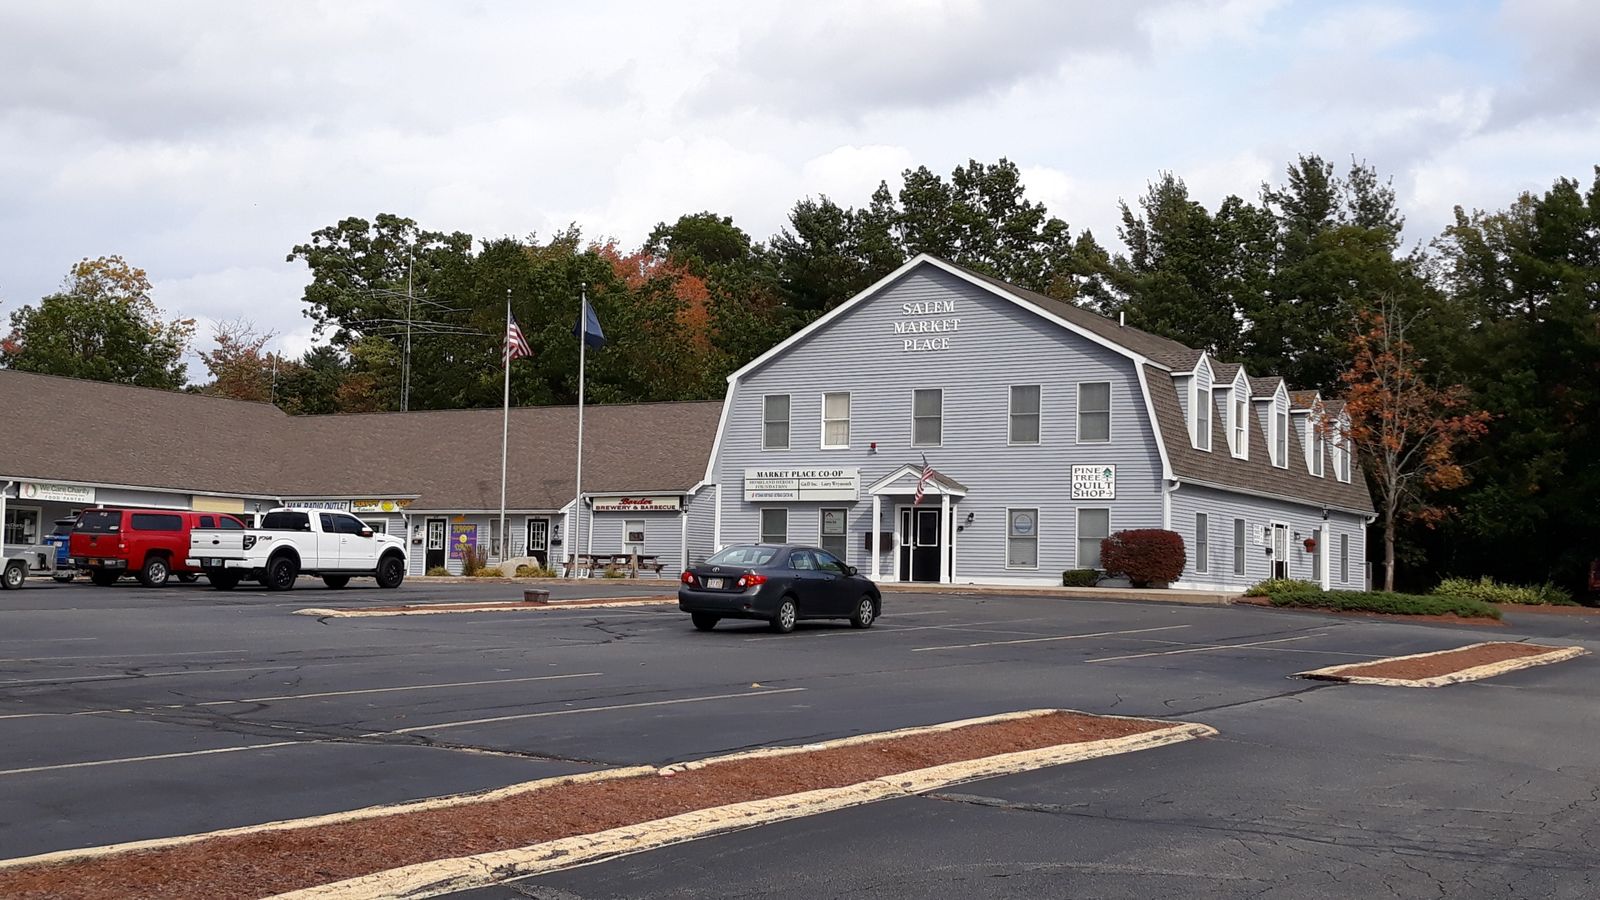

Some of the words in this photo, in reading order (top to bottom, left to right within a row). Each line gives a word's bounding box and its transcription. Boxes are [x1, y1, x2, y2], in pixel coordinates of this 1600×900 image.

[902, 300, 956, 315] SALEM
[893, 319, 961, 334] MARKET
[903, 338, 950, 351] PLACE
[791, 470, 816, 478] PLACE
[51, 485, 66, 493] Care
[67, 486, 90, 496] Charity
[1073, 482, 1113, 490] QUILT
[1073, 490, 1105, 498] SHOP
[324, 502, 349, 510] OUTLET
